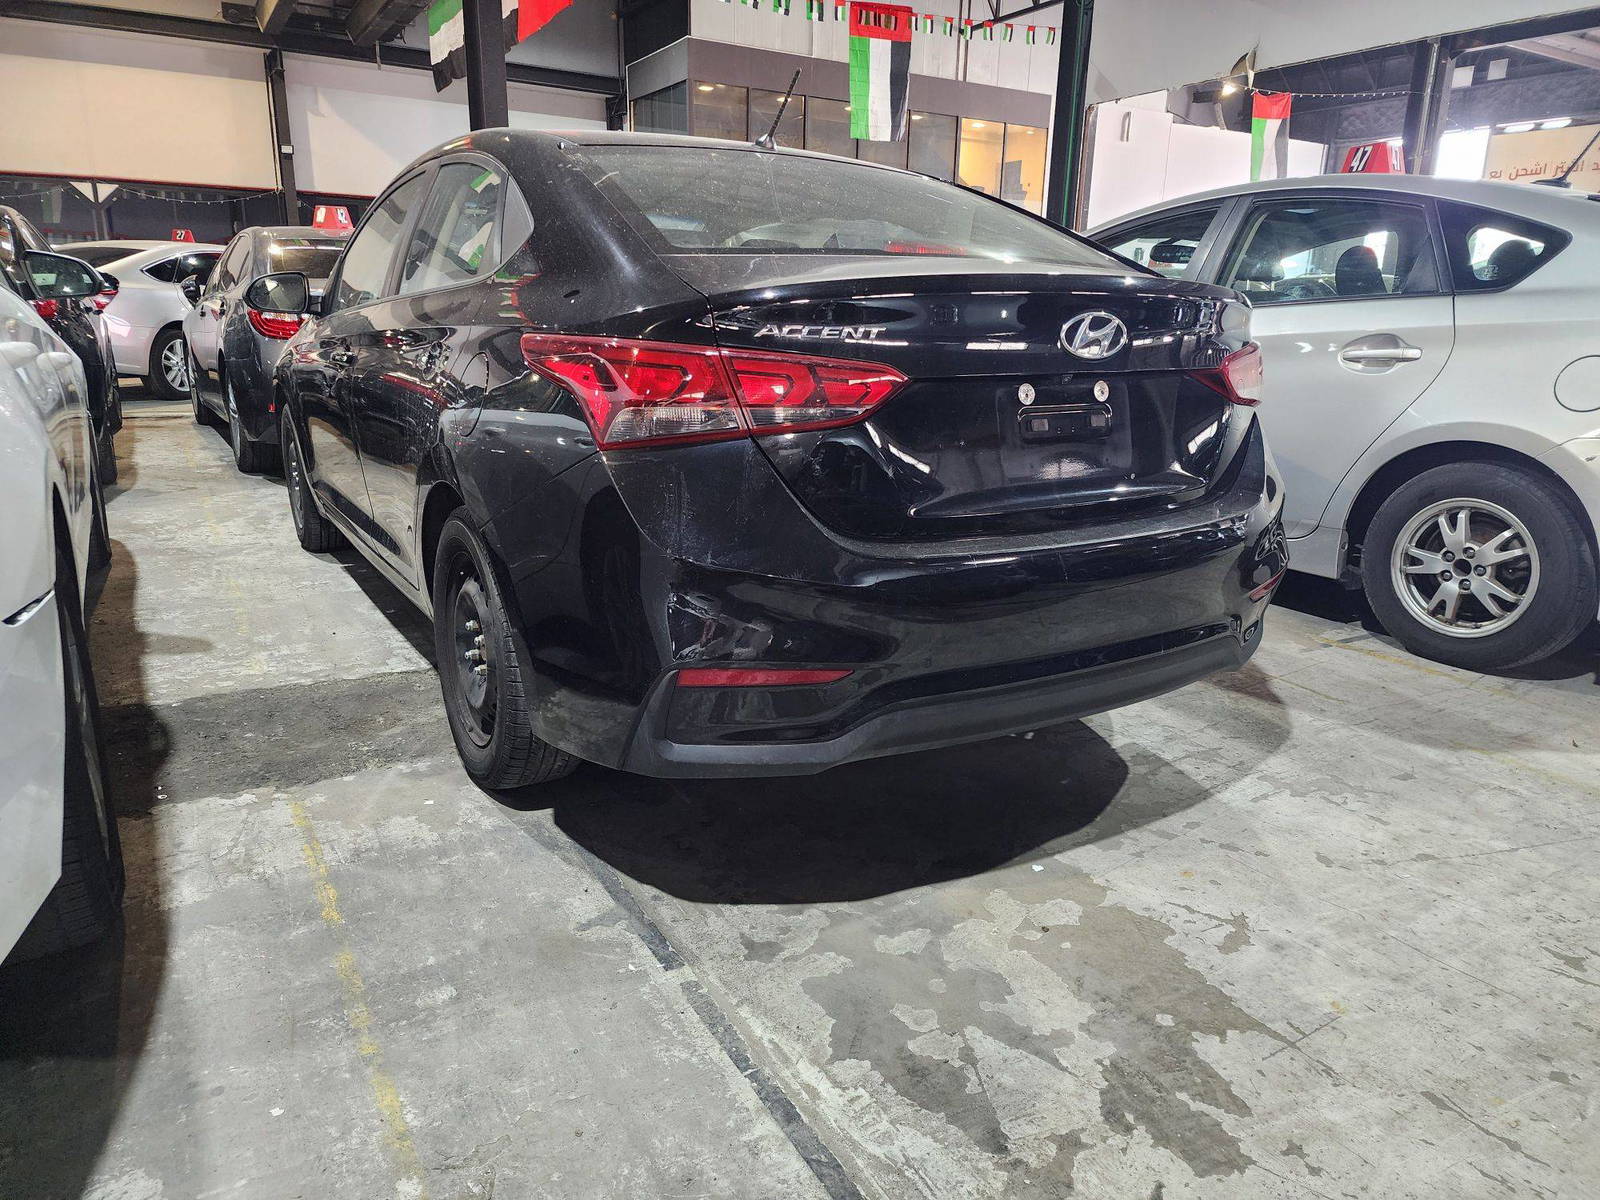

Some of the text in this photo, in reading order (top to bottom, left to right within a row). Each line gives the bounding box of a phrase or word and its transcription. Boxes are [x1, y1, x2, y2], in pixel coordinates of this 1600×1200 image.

[1350, 145, 1374, 173] 47
[176, 230, 186, 240] 27
[753, 324, 887, 340] ACCENT
